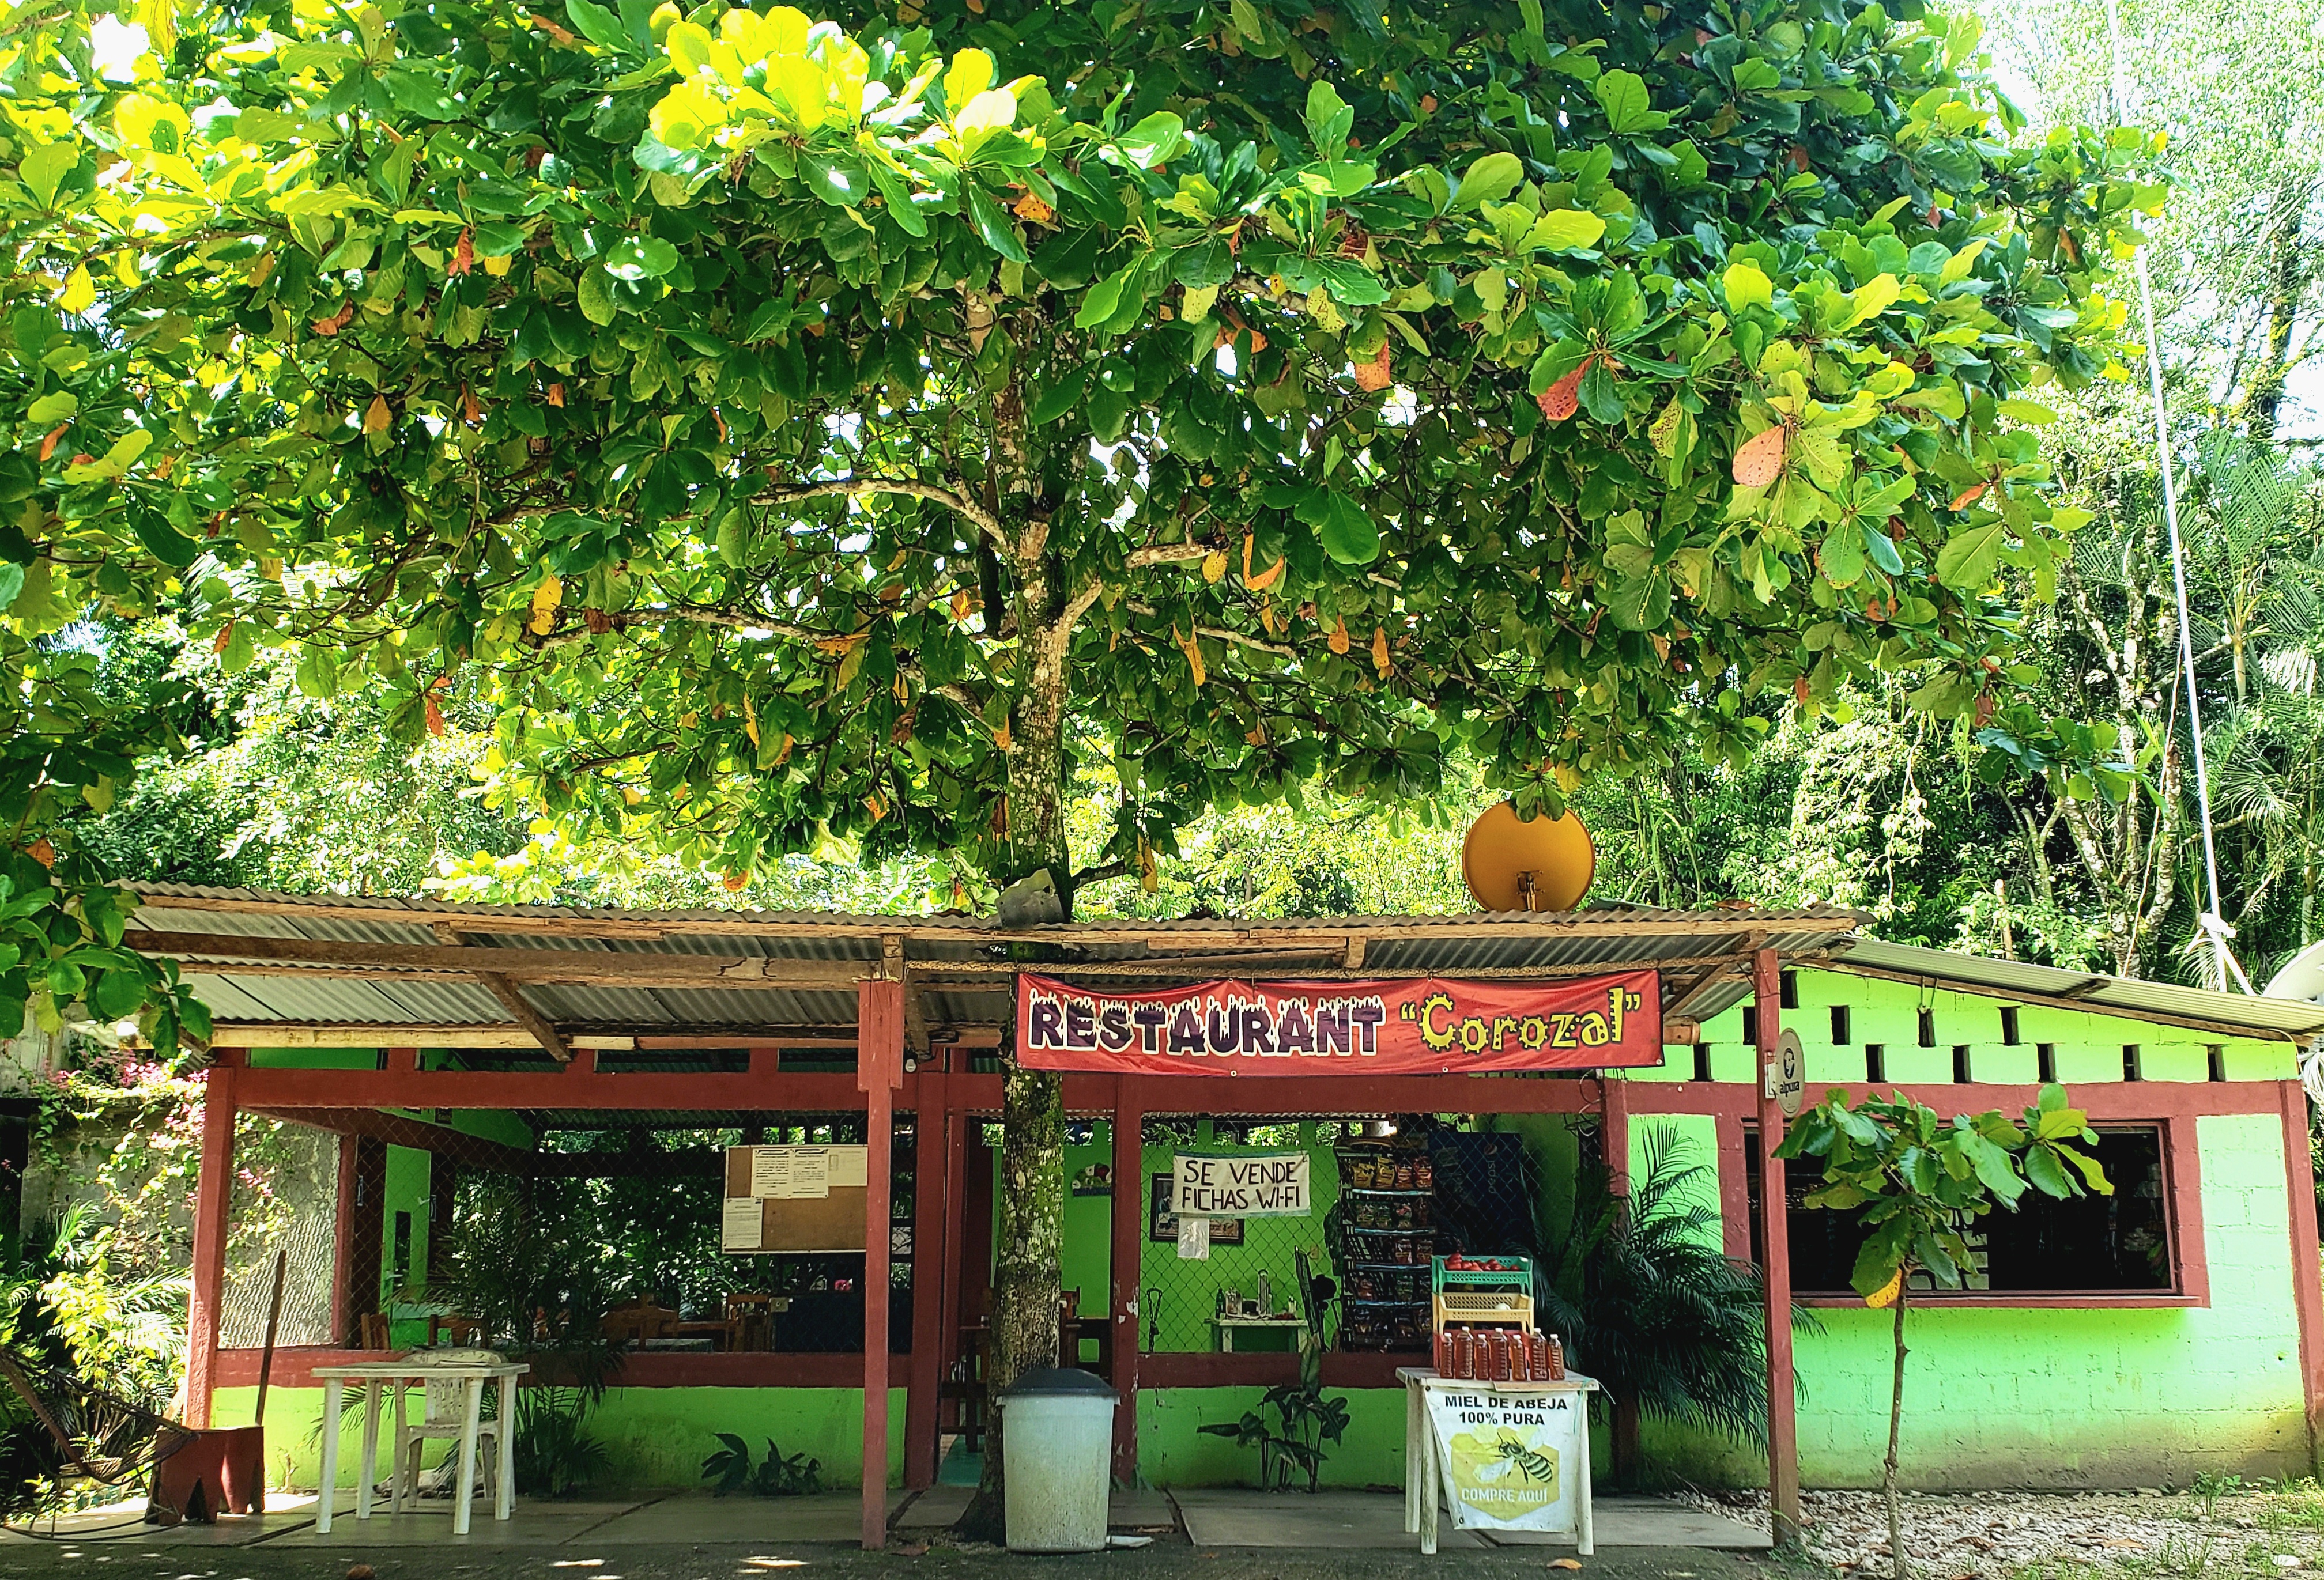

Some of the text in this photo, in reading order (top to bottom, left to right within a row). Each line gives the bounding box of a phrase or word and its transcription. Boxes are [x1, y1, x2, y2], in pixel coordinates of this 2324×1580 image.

[1028, 988, 1386, 1057] RESTAURANT
[1183, 1159, 1297, 1186] SE VENDE
[1182, 1185, 1300, 1211] FICHAS WI-FI
[1445, 1395, 1568, 1410] MIEL DE ABEJA
[1459, 1412, 1545, 1426] 100% PURA
[1461, 1487, 1548, 1503] COMPRE AQUÍ
